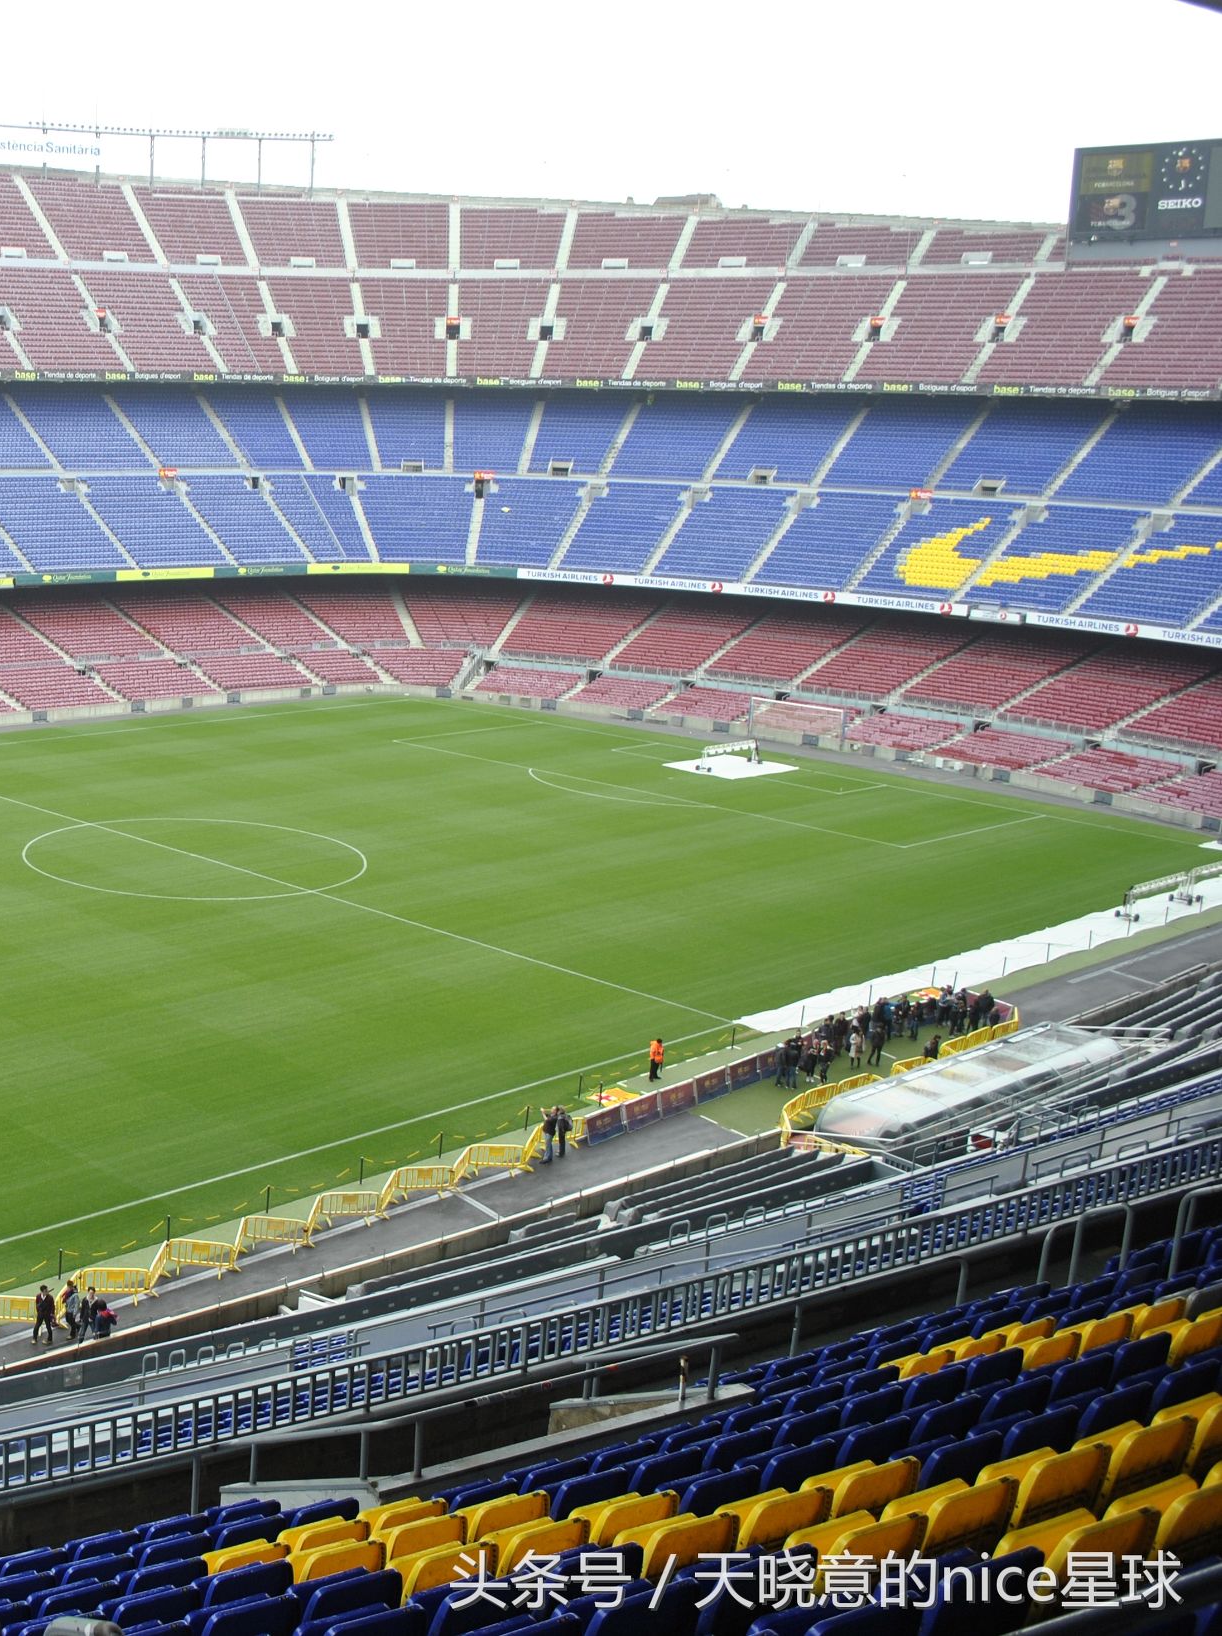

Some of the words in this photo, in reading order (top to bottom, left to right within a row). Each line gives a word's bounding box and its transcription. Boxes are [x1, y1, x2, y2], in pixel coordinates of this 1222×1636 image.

[1157, 198, 1202, 210] SEIKO
[526, 570, 561, 579] TURKISH
[561, 573, 598, 582] AIRLINES
[633, 577, 669, 587] TURKISH
[670, 580, 707, 590] AIRLINES
[743, 587, 779, 597] TURKISH
[780, 589, 819, 600] AIRLINES
[857, 597, 895, 608] TURKISH
[895, 600, 935, 611] AIRLINES
[1037, 615, 1076, 627] TURKISH
[1077, 619, 1119, 632] AIRLINES
[1162, 630, 1203, 643] TURKISH
